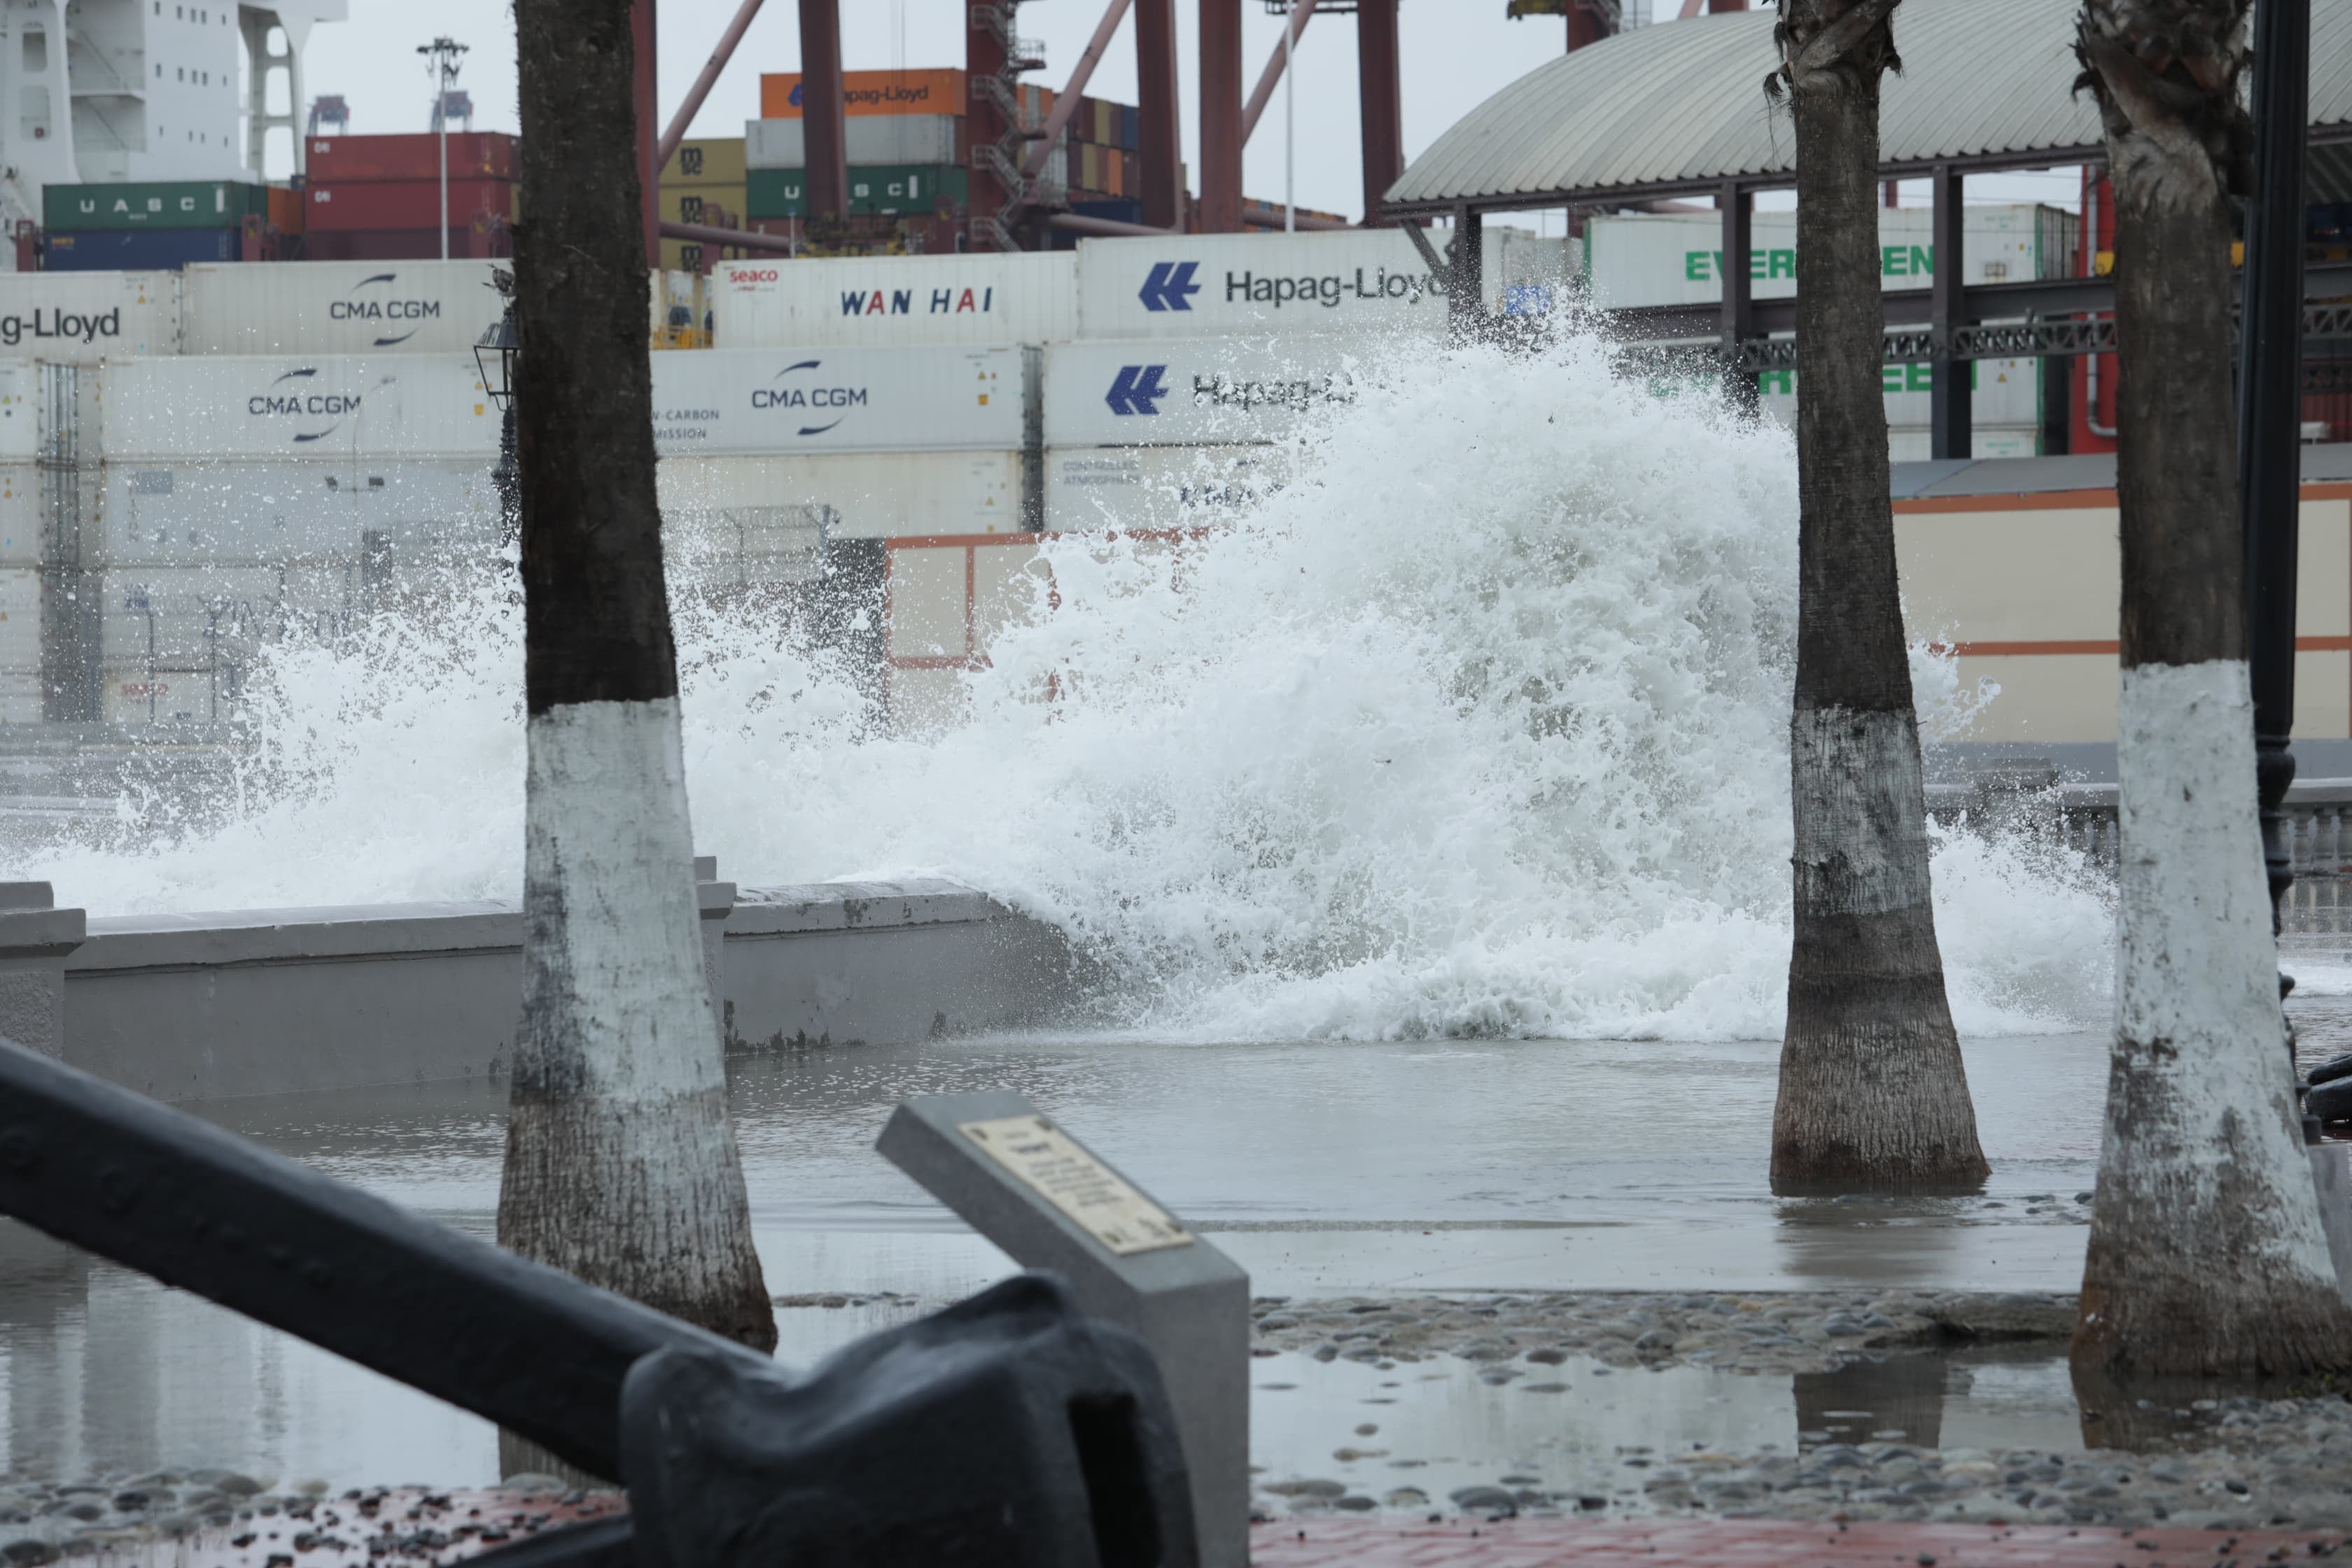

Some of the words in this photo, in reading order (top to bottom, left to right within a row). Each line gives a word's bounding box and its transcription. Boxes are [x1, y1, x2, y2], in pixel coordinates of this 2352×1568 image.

[844, 85, 929, 105] pag-Lloyd
[785, 183, 902, 199] USC
[730, 270, 778, 283] seaco
[330, 301, 382, 319] CMA
[387, 300, 440, 318] CGM
[841, 290, 911, 316] WAN
[930, 287, 992, 314] HAI
[1, 306, 120, 346] g-Lloyd
[248, 396, 302, 414] CMA
[307, 395, 360, 414] CGM
[752, 389, 806, 408] CMA
[811, 388, 867, 407] CGM
[650, 409, 720, 421] W-CARBON
[652, 427, 707, 440] MISSION
